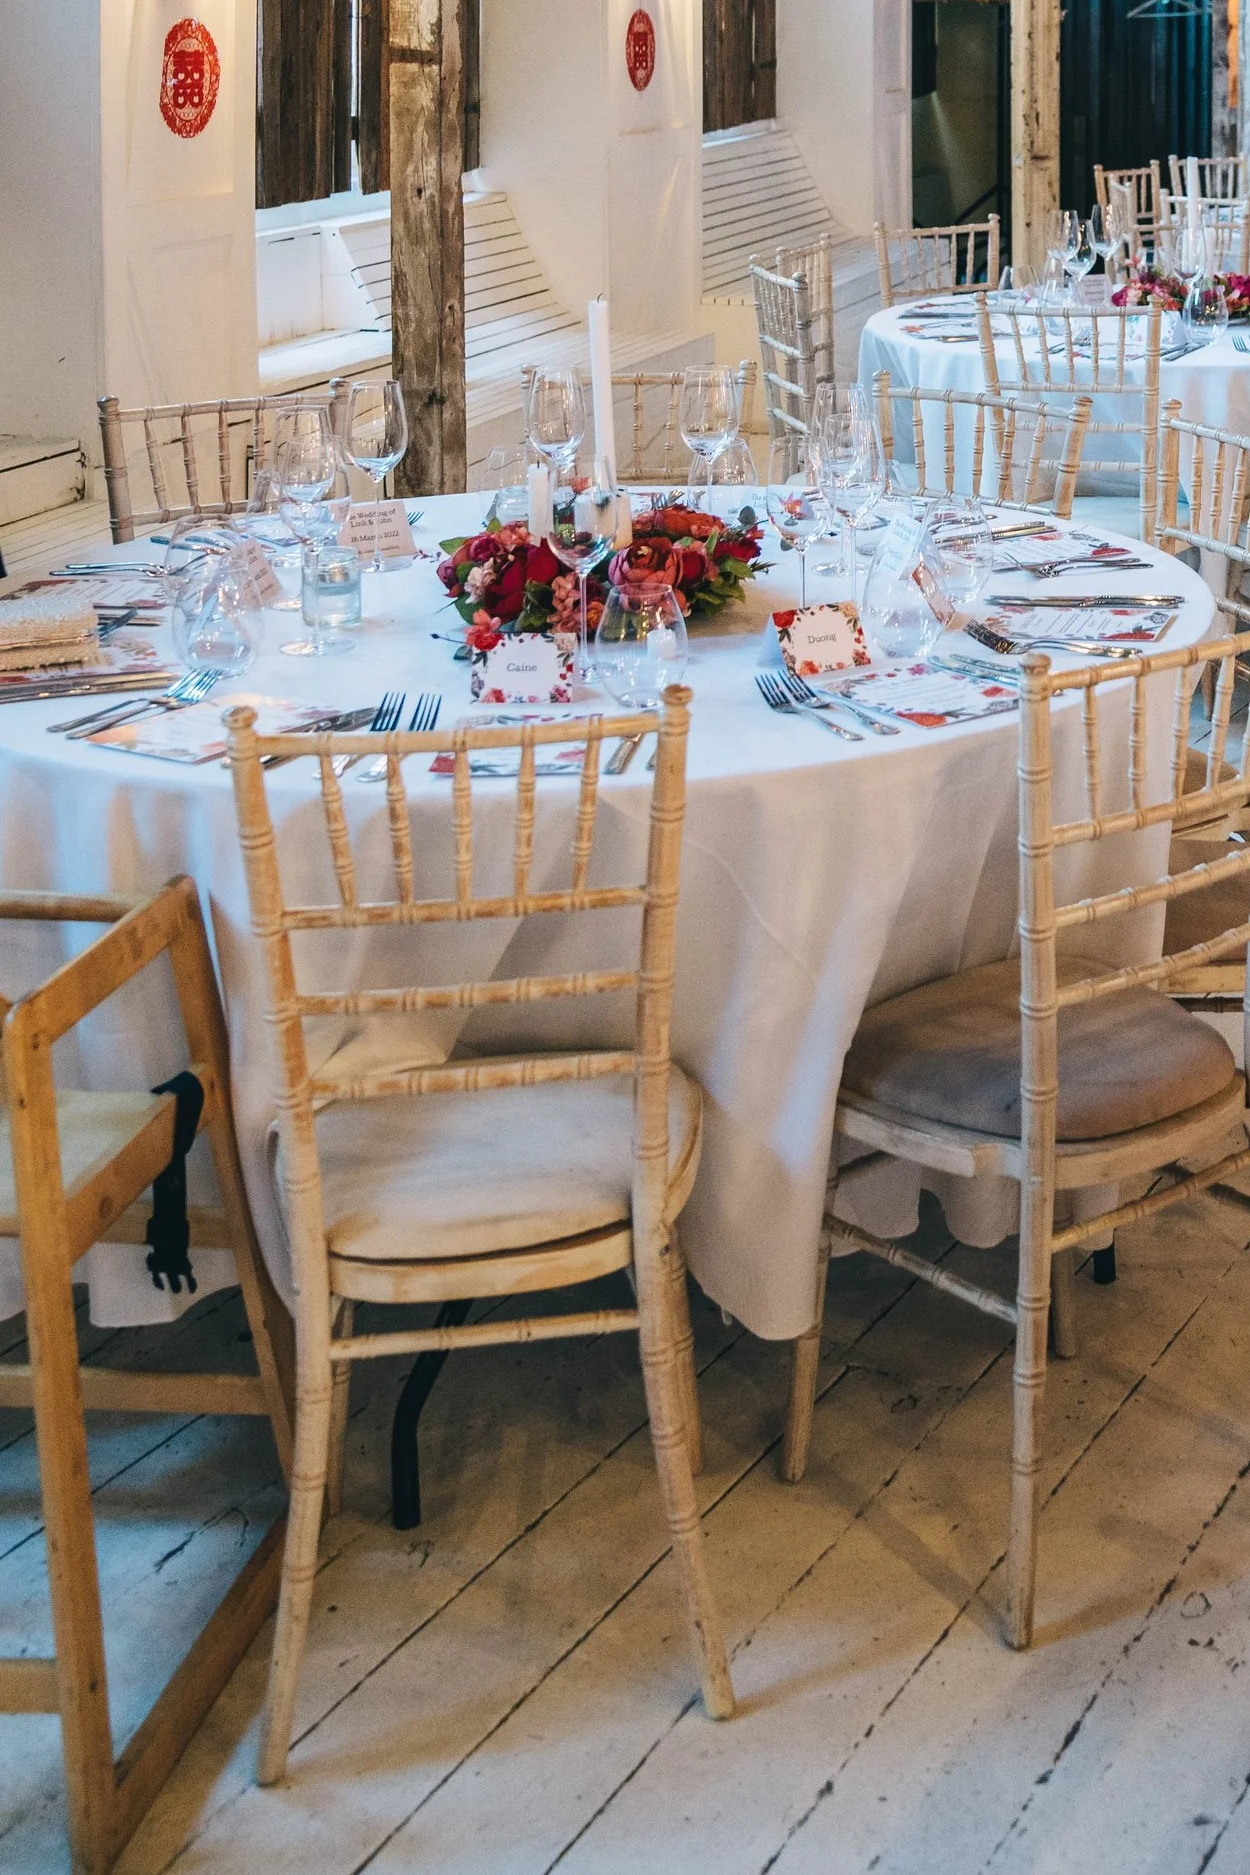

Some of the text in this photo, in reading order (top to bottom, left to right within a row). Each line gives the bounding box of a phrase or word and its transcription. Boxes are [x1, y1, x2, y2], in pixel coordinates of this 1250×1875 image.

[359, 534, 383, 542] Marh
[383, 530, 400, 538] 2022
[807, 634, 837, 644] Duong
